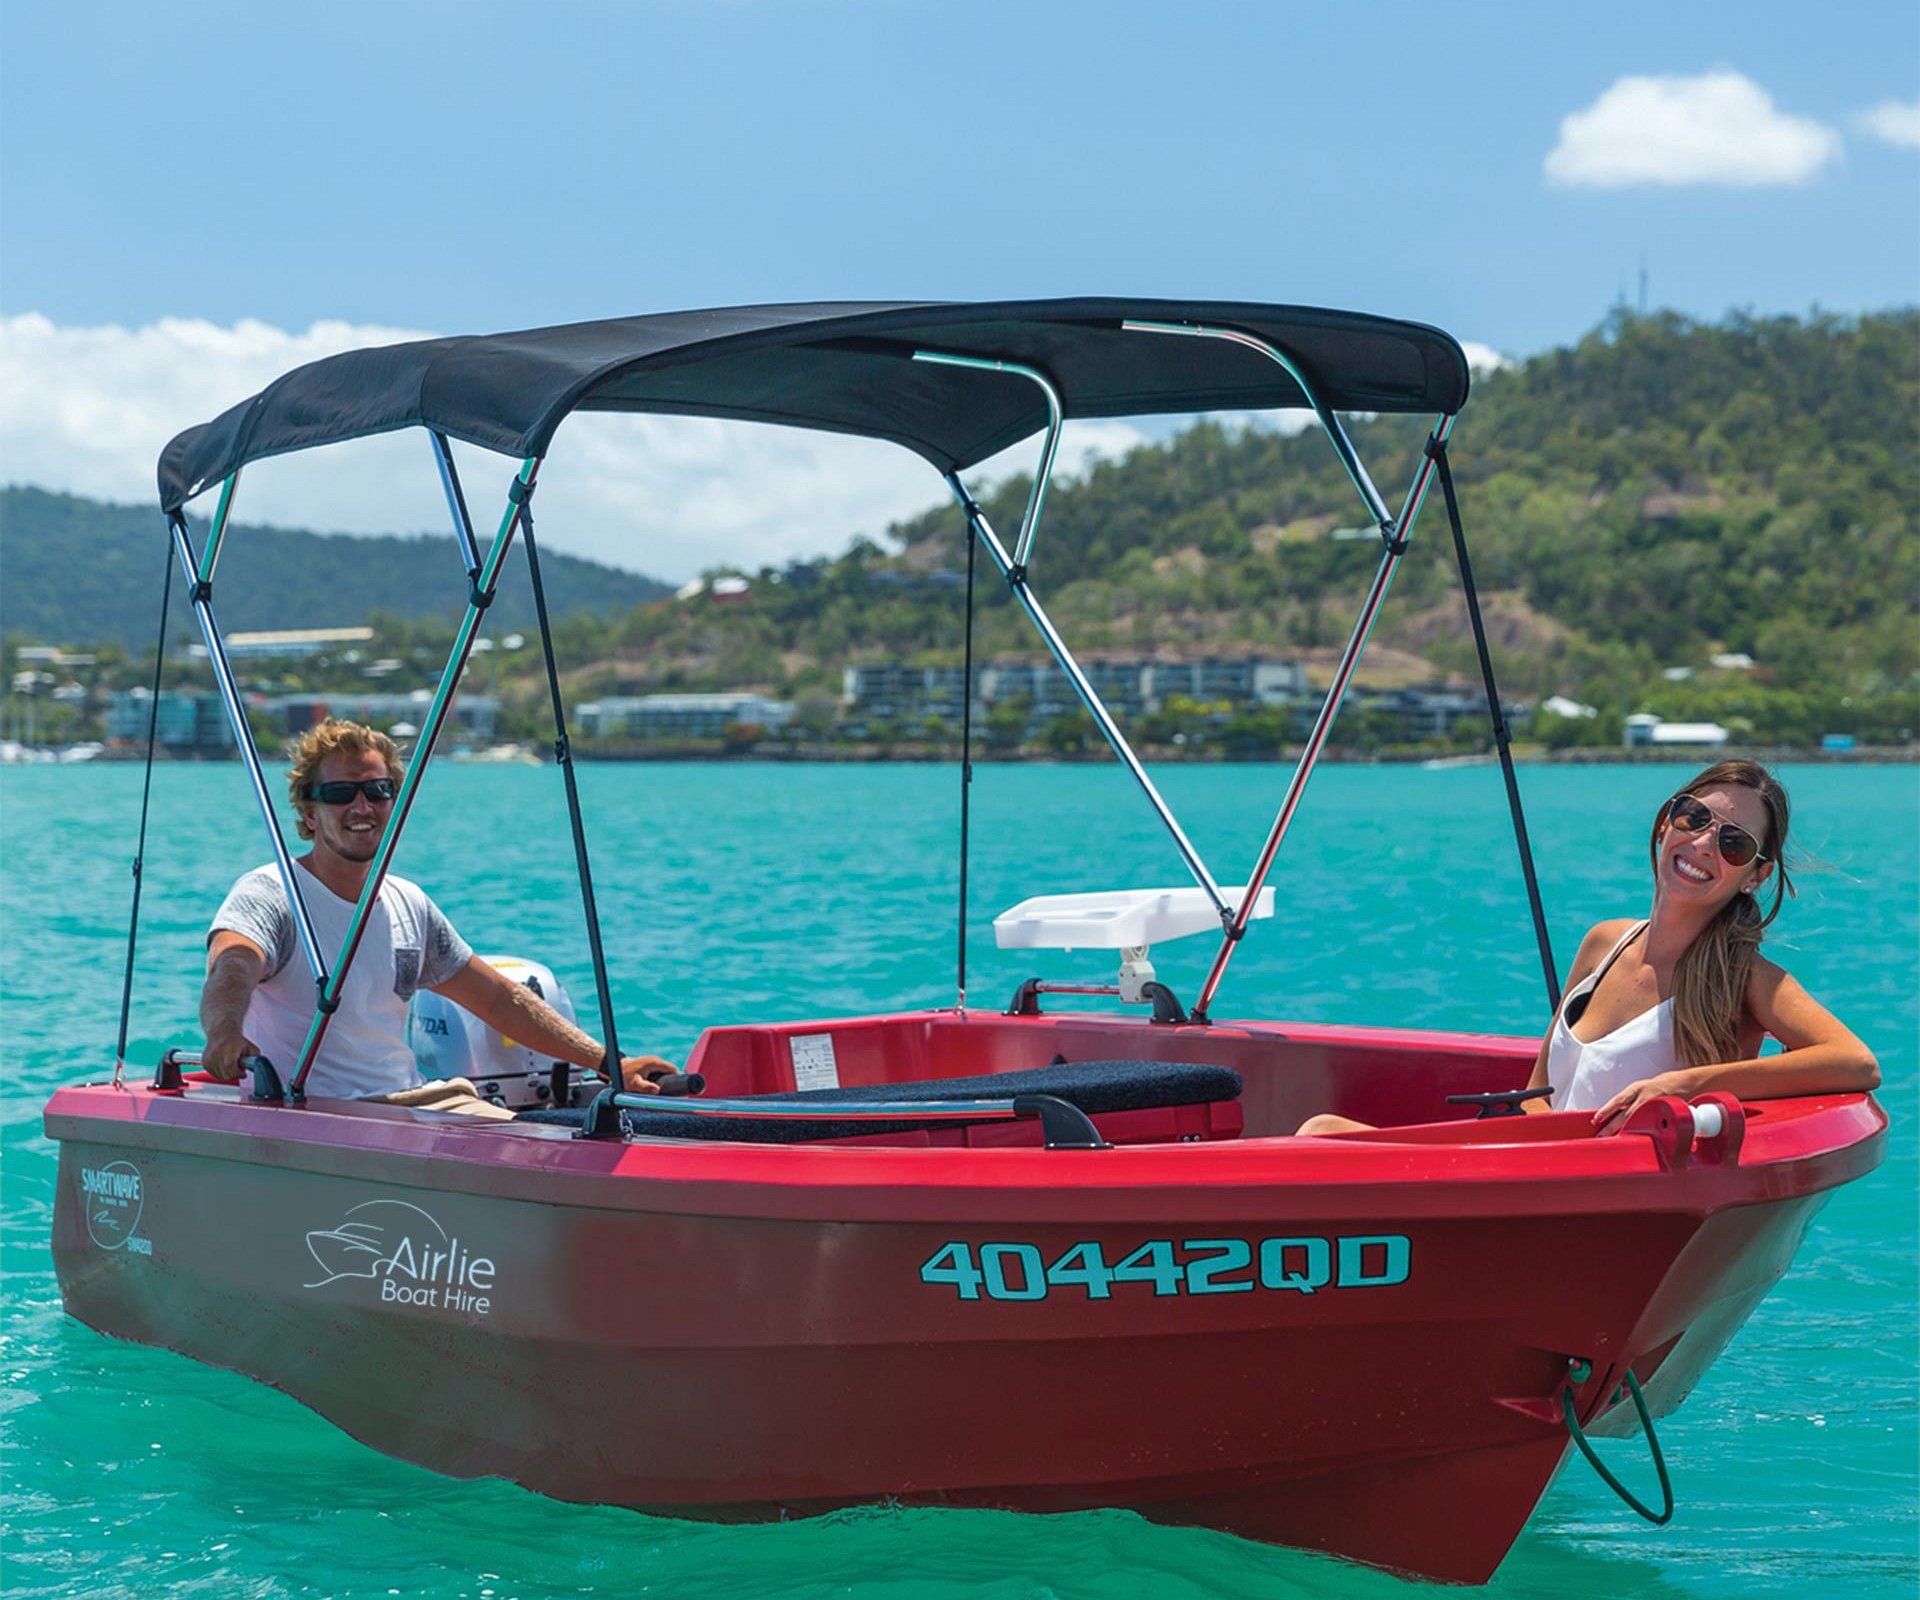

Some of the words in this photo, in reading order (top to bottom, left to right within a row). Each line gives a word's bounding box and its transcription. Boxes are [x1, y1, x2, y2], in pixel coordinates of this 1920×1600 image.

[82, 1168, 140, 1200] SMARTWAVE
[386, 1237, 495, 1289] Airlie
[919, 1234, 1412, 1301] 40442QD
[381, 1279, 437, 1307] Boat
[443, 1287, 490, 1314] Hire
